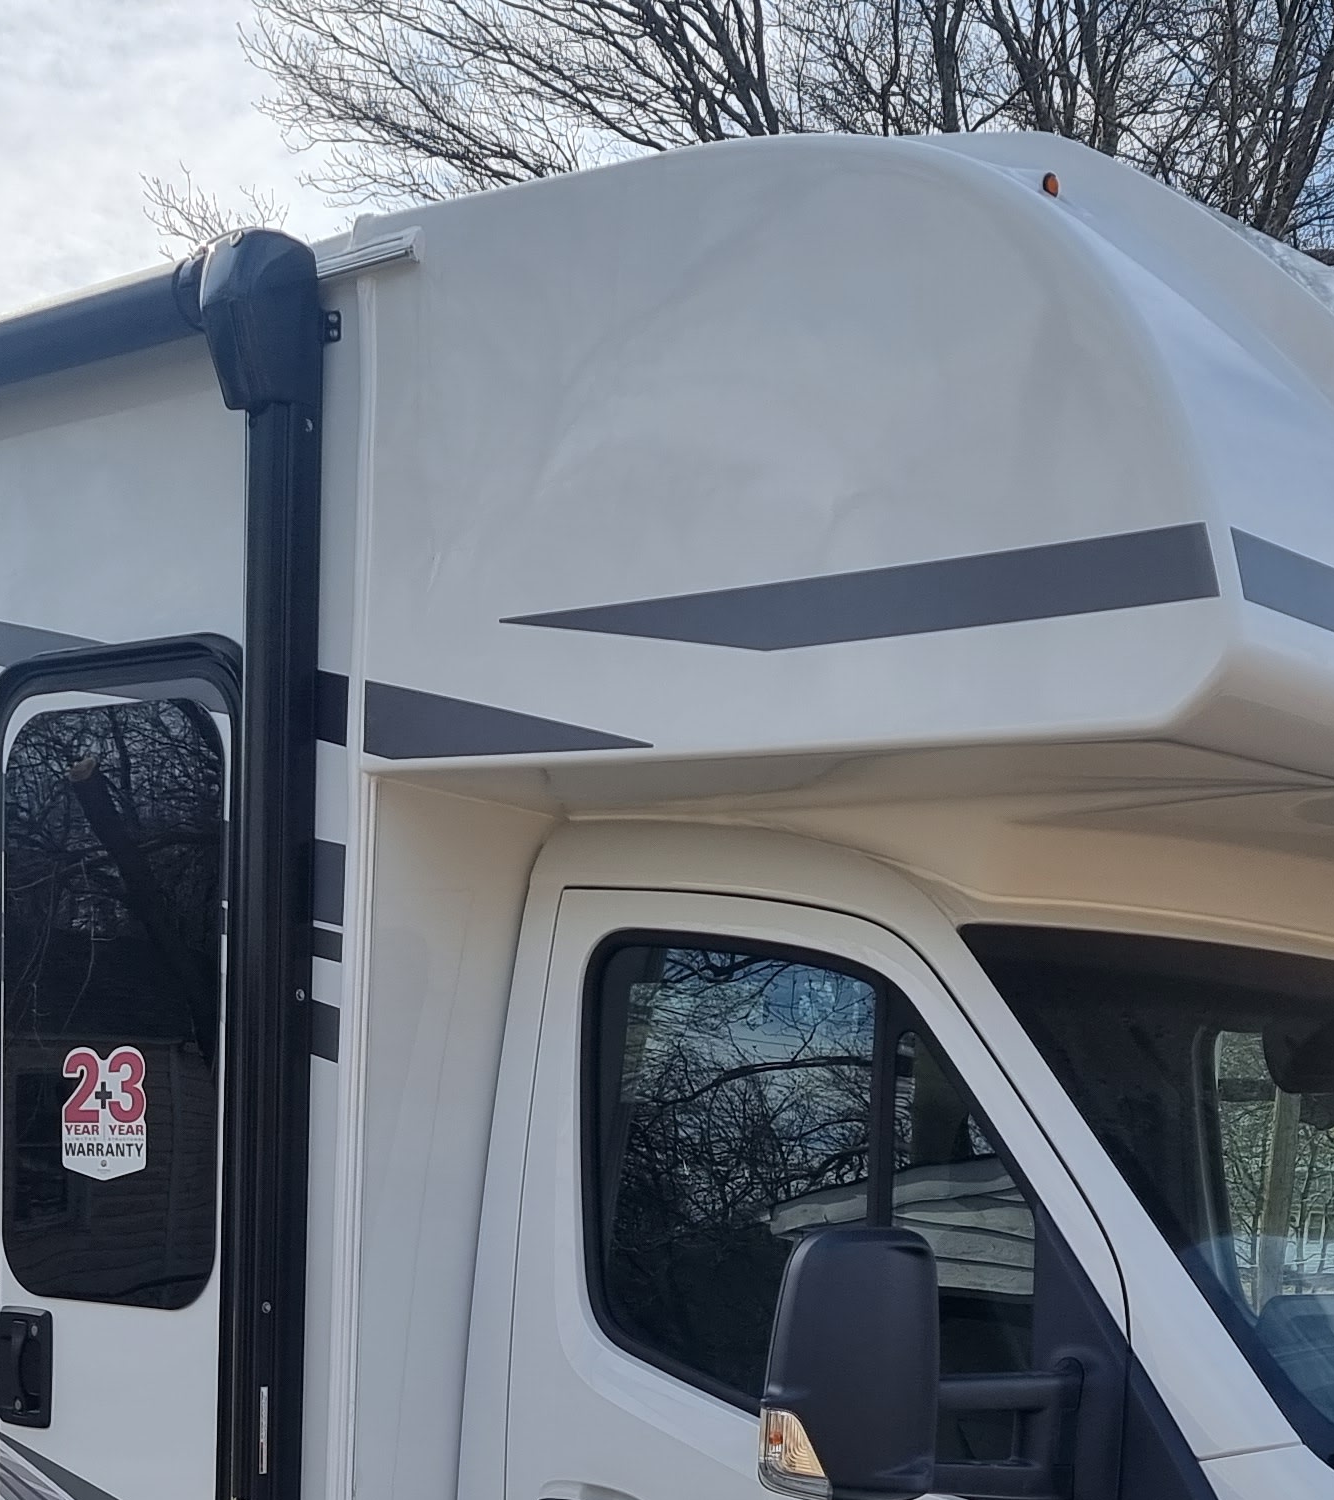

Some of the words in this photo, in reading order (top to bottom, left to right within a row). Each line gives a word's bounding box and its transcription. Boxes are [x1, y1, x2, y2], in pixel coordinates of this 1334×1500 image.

[64, 1124, 100, 1136] YEAR
[108, 1124, 144, 1136] YEAR
[64, 1142, 144, 1158] WARRANTY
